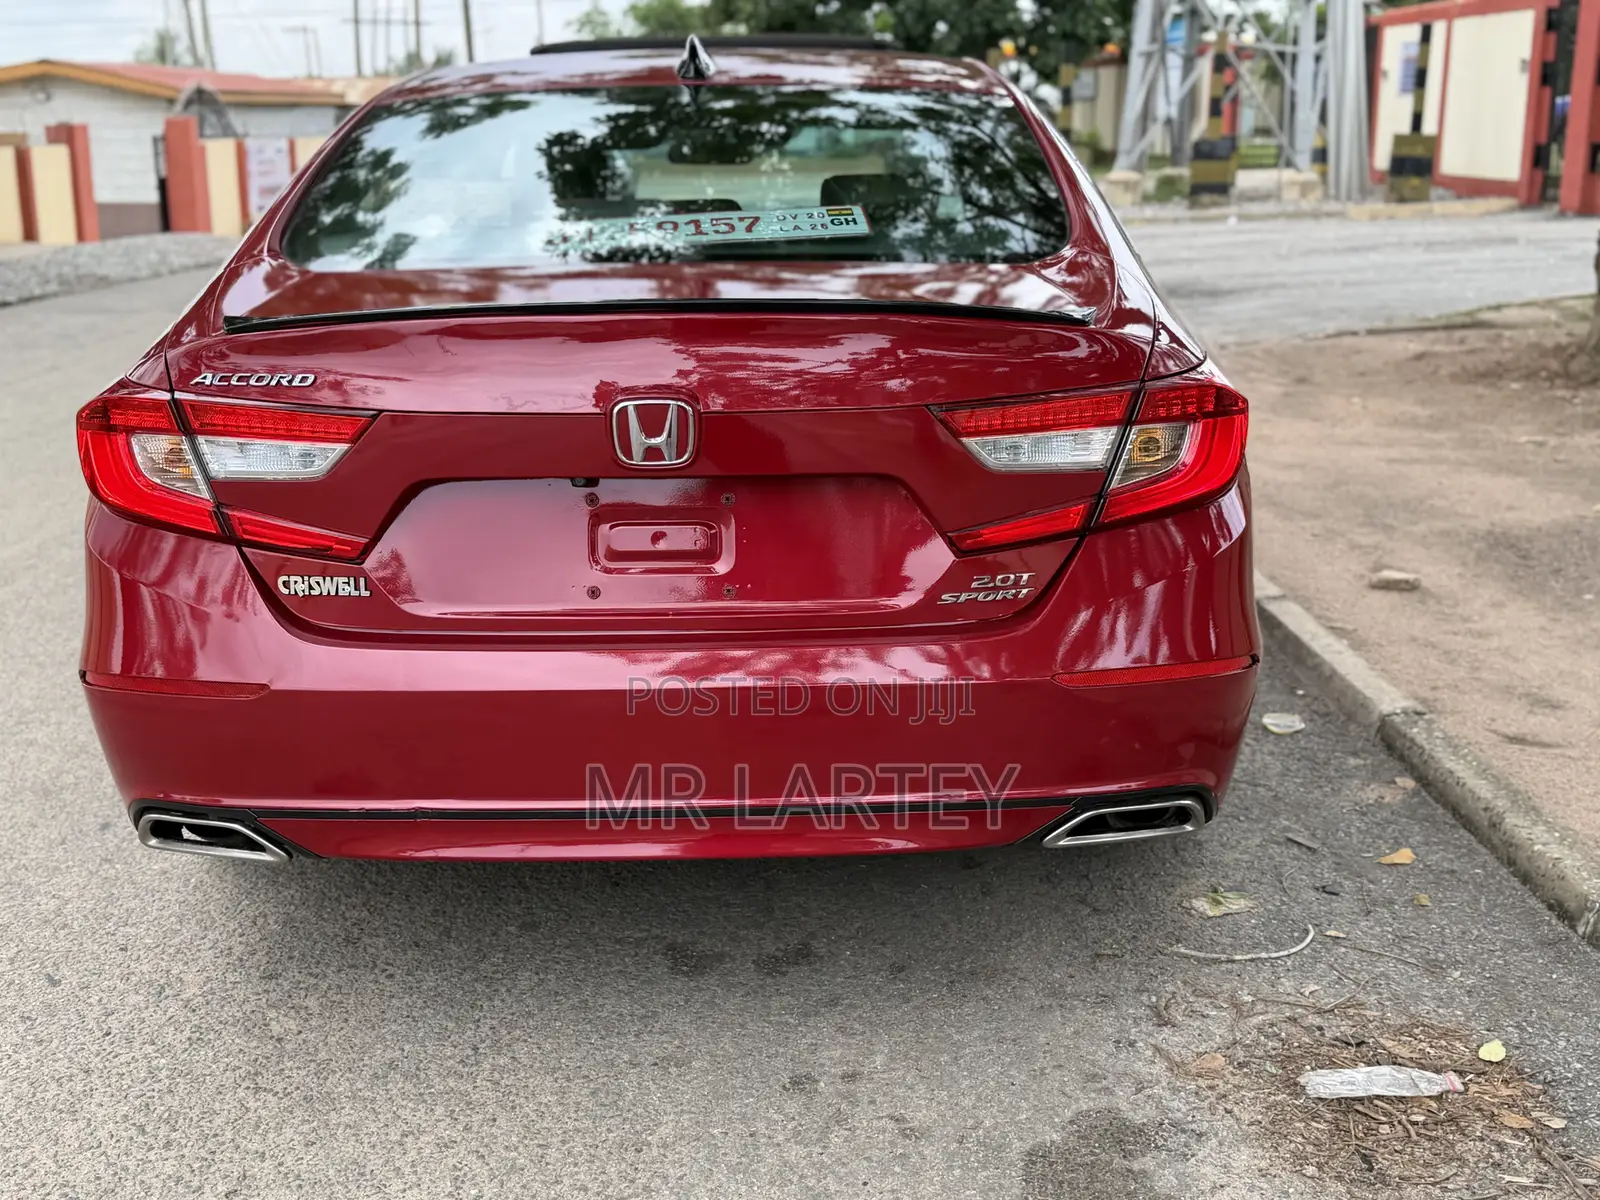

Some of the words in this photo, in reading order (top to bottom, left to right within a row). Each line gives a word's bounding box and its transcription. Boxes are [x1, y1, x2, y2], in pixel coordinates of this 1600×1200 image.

[829, 217, 858, 226] GH
[189, 373, 316, 386] ACCORD
[936, 588, 1035, 605] SPORT
